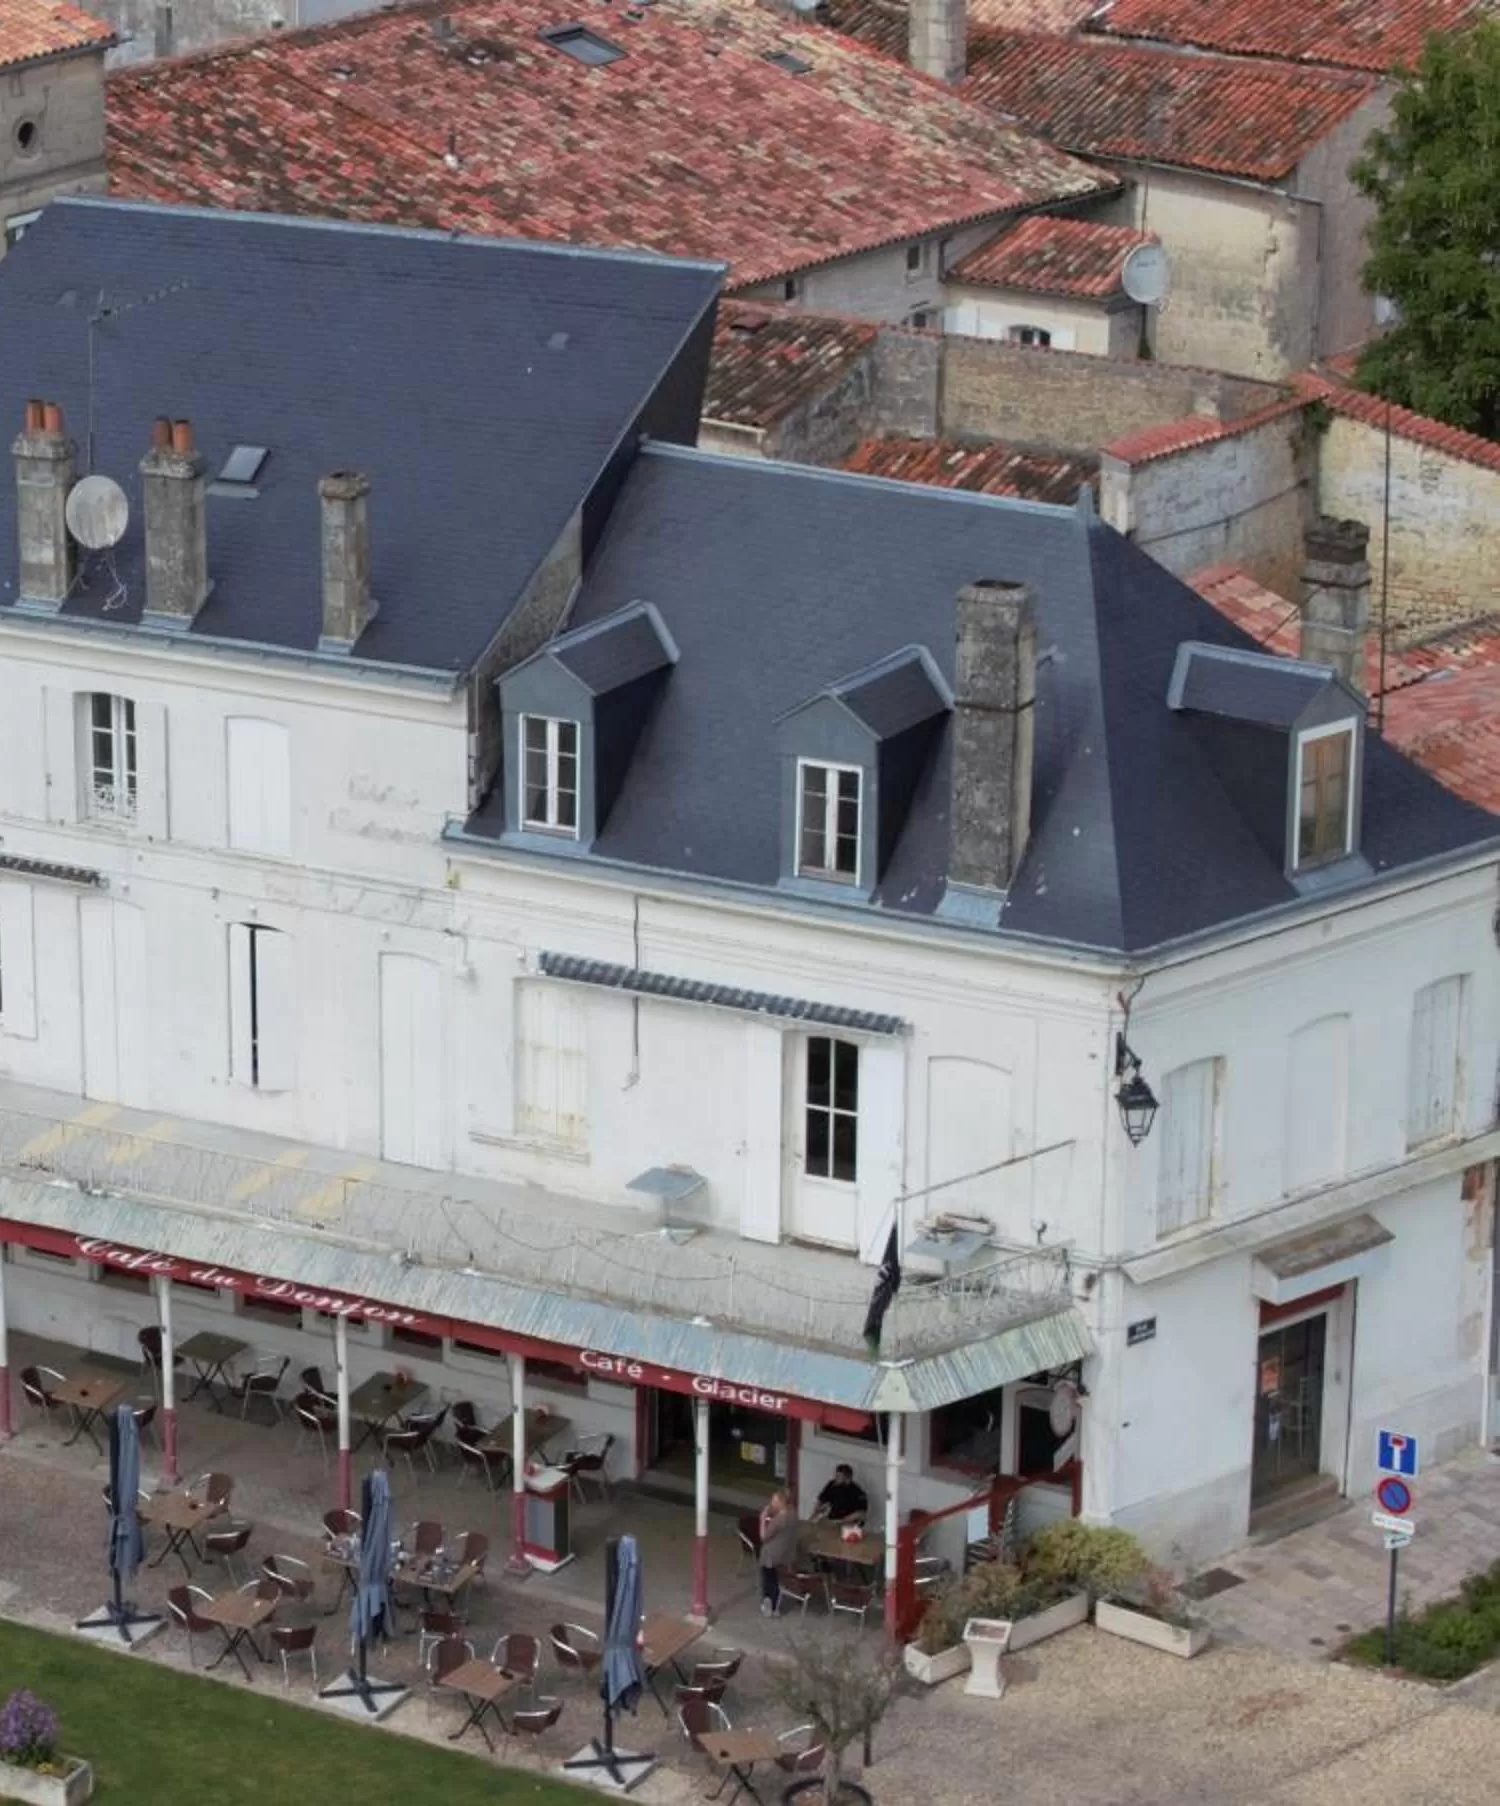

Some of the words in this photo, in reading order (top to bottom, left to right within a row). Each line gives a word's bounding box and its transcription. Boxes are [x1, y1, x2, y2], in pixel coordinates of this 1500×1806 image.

[75, 1236, 180, 1270] Café
[190, 1267, 242, 1287] du
[254, 1276, 426, 1325] Donjon
[579, 1350, 643, 1379] Café
[691, 1375, 789, 1411] Glacier
